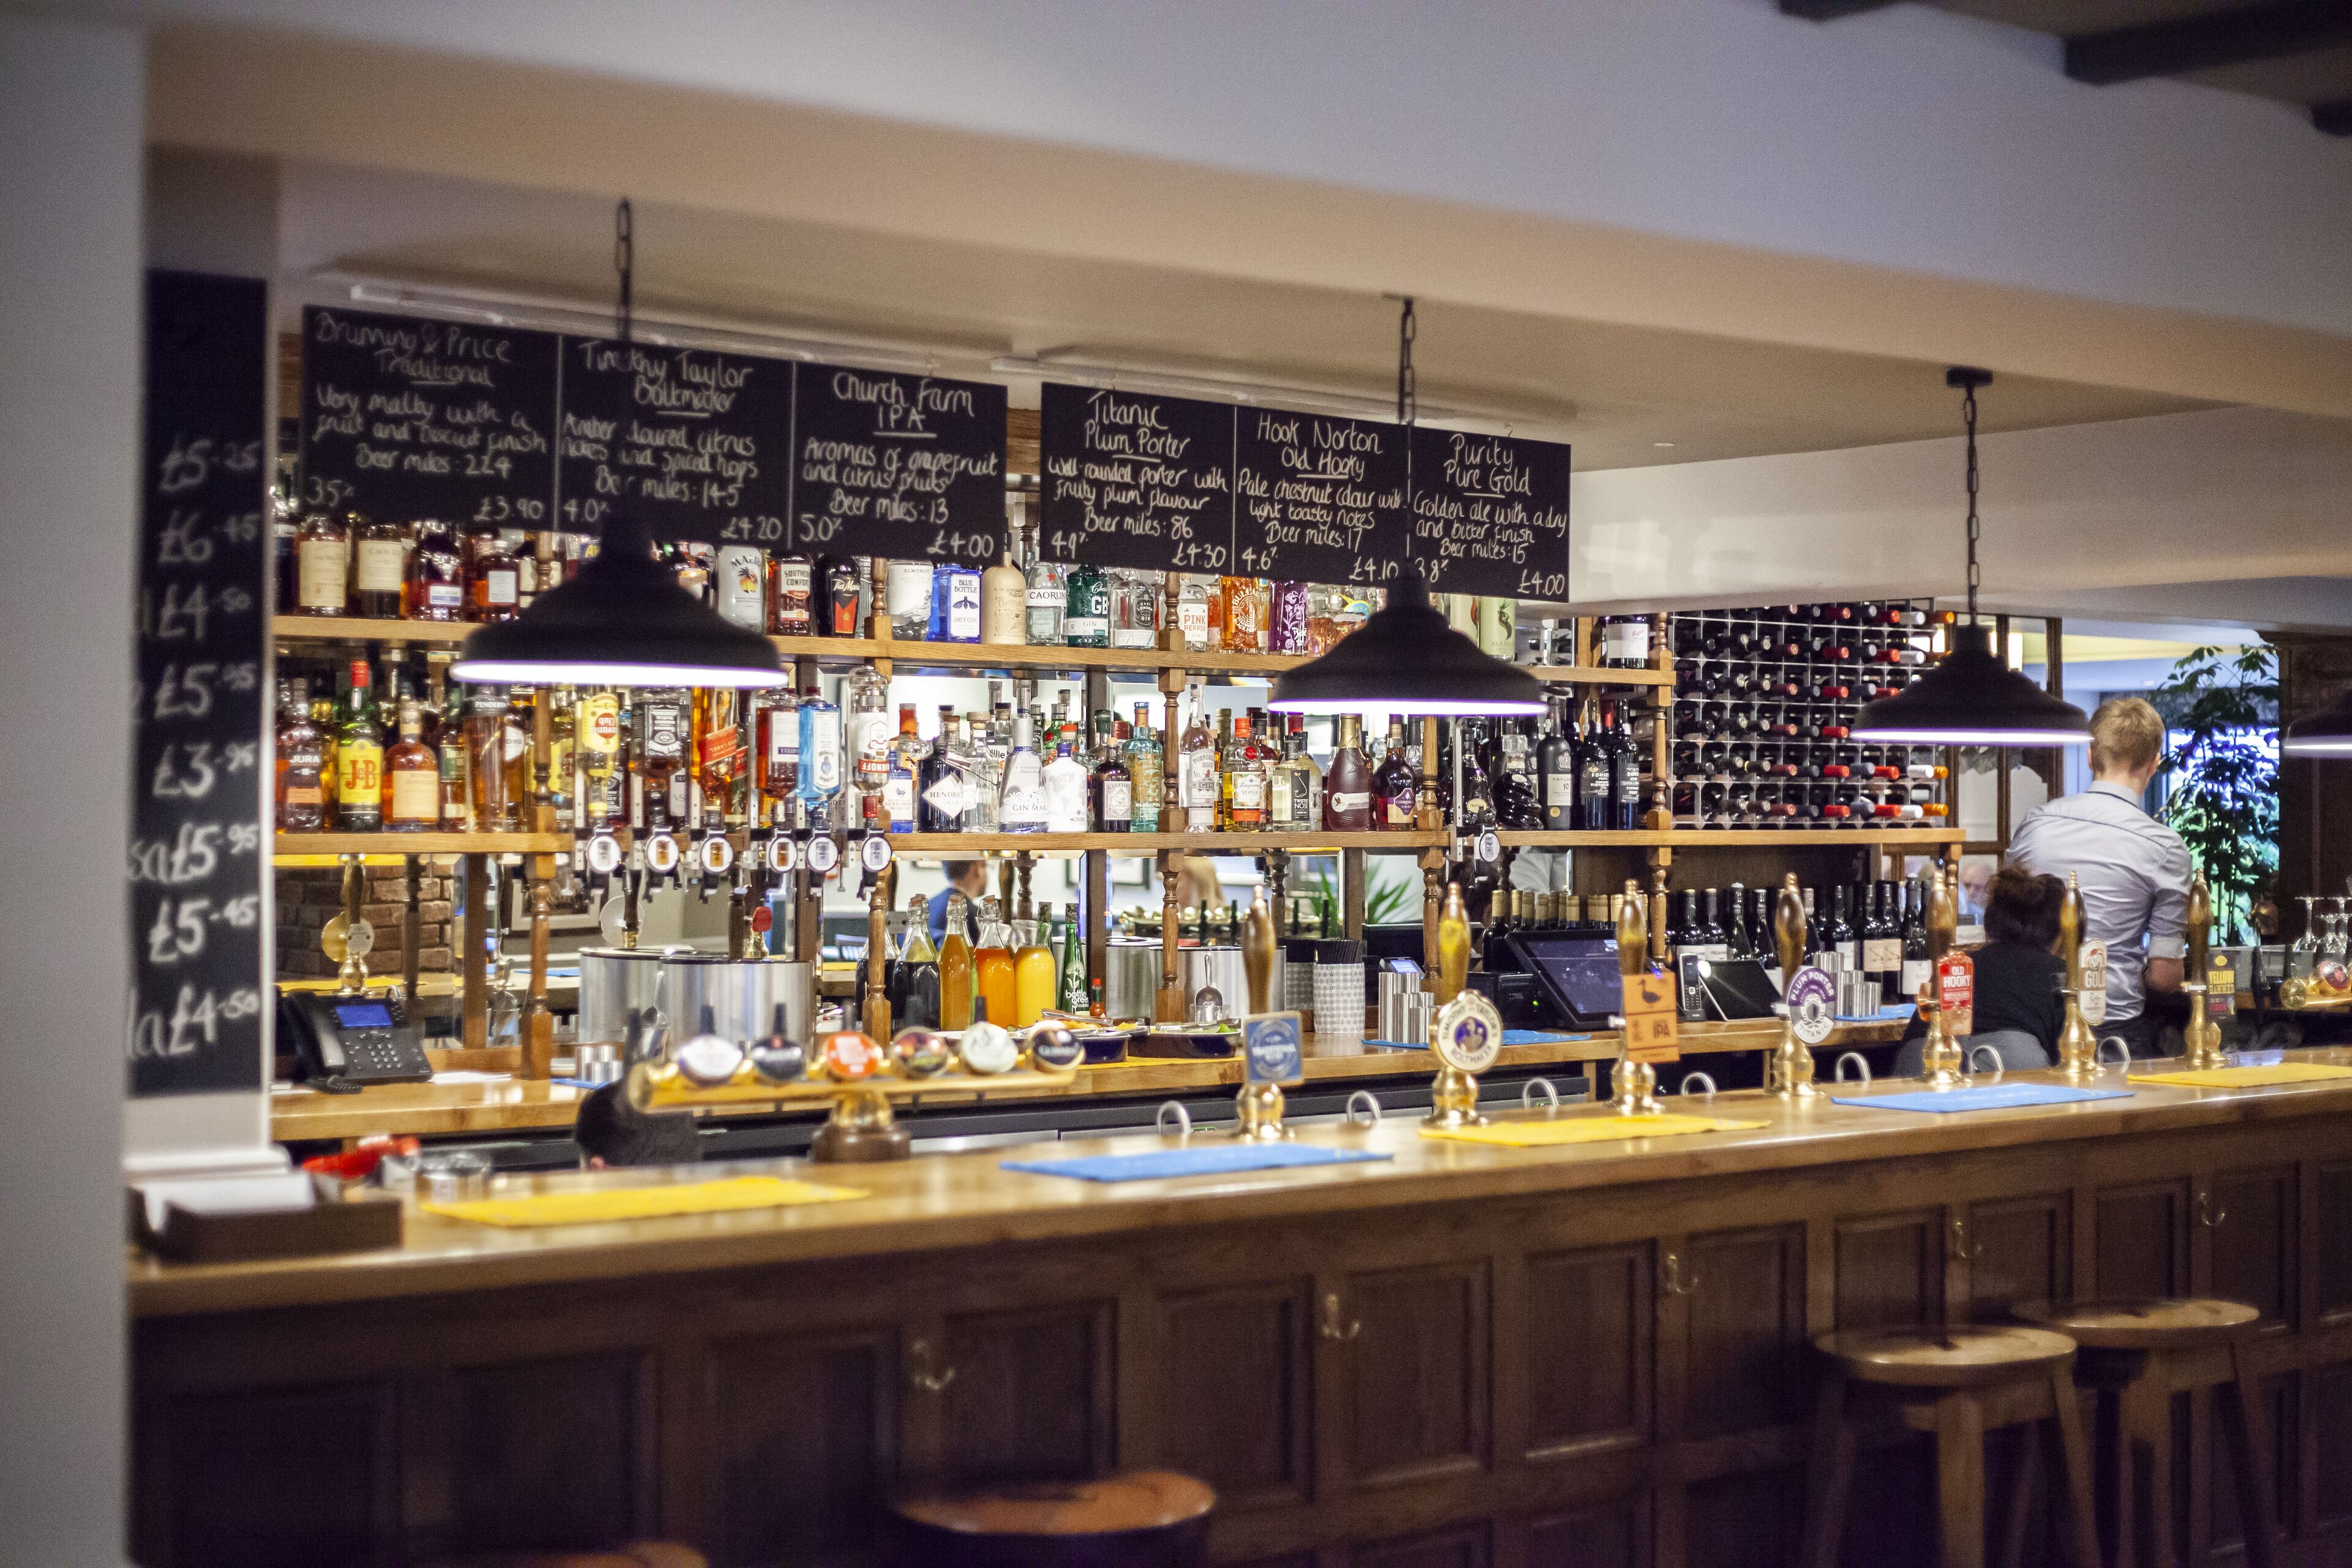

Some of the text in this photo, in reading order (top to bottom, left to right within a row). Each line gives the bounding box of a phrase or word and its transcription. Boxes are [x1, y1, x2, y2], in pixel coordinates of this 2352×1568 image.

[447, 326, 513, 363] Price
[579, 340, 754, 390] Timthy Taylor
[317, 383, 531, 430] Very malty with a
[635, 374, 736, 412] Boltmaker
[833, 372, 974, 417] Church Farm
[879, 405, 926, 430] IPA
[1087, 391, 1169, 429] Titanic
[373, 422, 411, 440] and
[489, 428, 548, 456] finish
[564, 412, 617, 441] Amber
[698, 428, 756, 457] citrus
[1085, 420, 1190, 458] Plum Porter
[1258, 412, 1383, 454] Hook Norton
[356, 443, 399, 469] Beer
[560, 437, 609, 461] notes
[661, 451, 713, 481] spiced
[717, 454, 758, 488] hops
[804, 437, 998, 484] Aromas of grapefruit
[1282, 447, 1364, 482] Old Hooky
[1450, 434, 1513, 472] Purity
[595, 465, 635, 495] Ber
[802, 463, 951, 496] and citrus fruits
[1139, 465, 1187, 491] porter
[1194, 467, 1229, 492] with
[1238, 467, 1270, 497] Pale
[1275, 478, 1332, 504] chestnut
[1336, 484, 1374, 508] colour
[1444, 459, 1531, 496] Pure Gold
[829, 488, 870, 514] Beer
[930, 498, 948, 524] 13
[1104, 484, 1143, 510] plum
[1146, 487, 1210, 516] flavour
[1250, 499, 1374, 529] light toasty notes
[1414, 491, 1464, 519] Golden
[1470, 499, 1491, 521] ale
[1495, 501, 1529, 525] with
[1546, 506, 1567, 537] dry
[1085, 505, 1120, 532] Beer
[1171, 516, 1193, 540] 86
[1265, 521, 1300, 544] Beer
[1348, 528, 1363, 553] 17
[1417, 519, 1536, 548] and bitter finish
[927, 529, 994, 557] £4.00
[1172, 541, 1226, 568] £4.30
[1441, 538, 1466, 558] Beer
[1512, 543, 1529, 564] 15
[731, 554, 761, 569] MALIB
[1090, 581, 1108, 594] Cha
[1517, 568, 1565, 595] £4.00
[1184, 614, 1205, 624] PINK
[290, 755, 320, 764] JURA
[1790, 974, 1808, 1001] PLUM
[1809, 971, 1834, 997] PORTER
[1943, 975, 1971, 988] HOOKY
[1951, 966, 1965, 976] OLD
[2085, 970, 2106, 989] GOLD
[1066, 989, 1087, 998] bottle
[1442, 1005, 1466, 1040] TIMOTHY
[1653, 1023, 1670, 1039] IPA
[1800, 1023, 1829, 1038] TITANIC
[1450, 1044, 1492, 1064] BOLTMAKER
